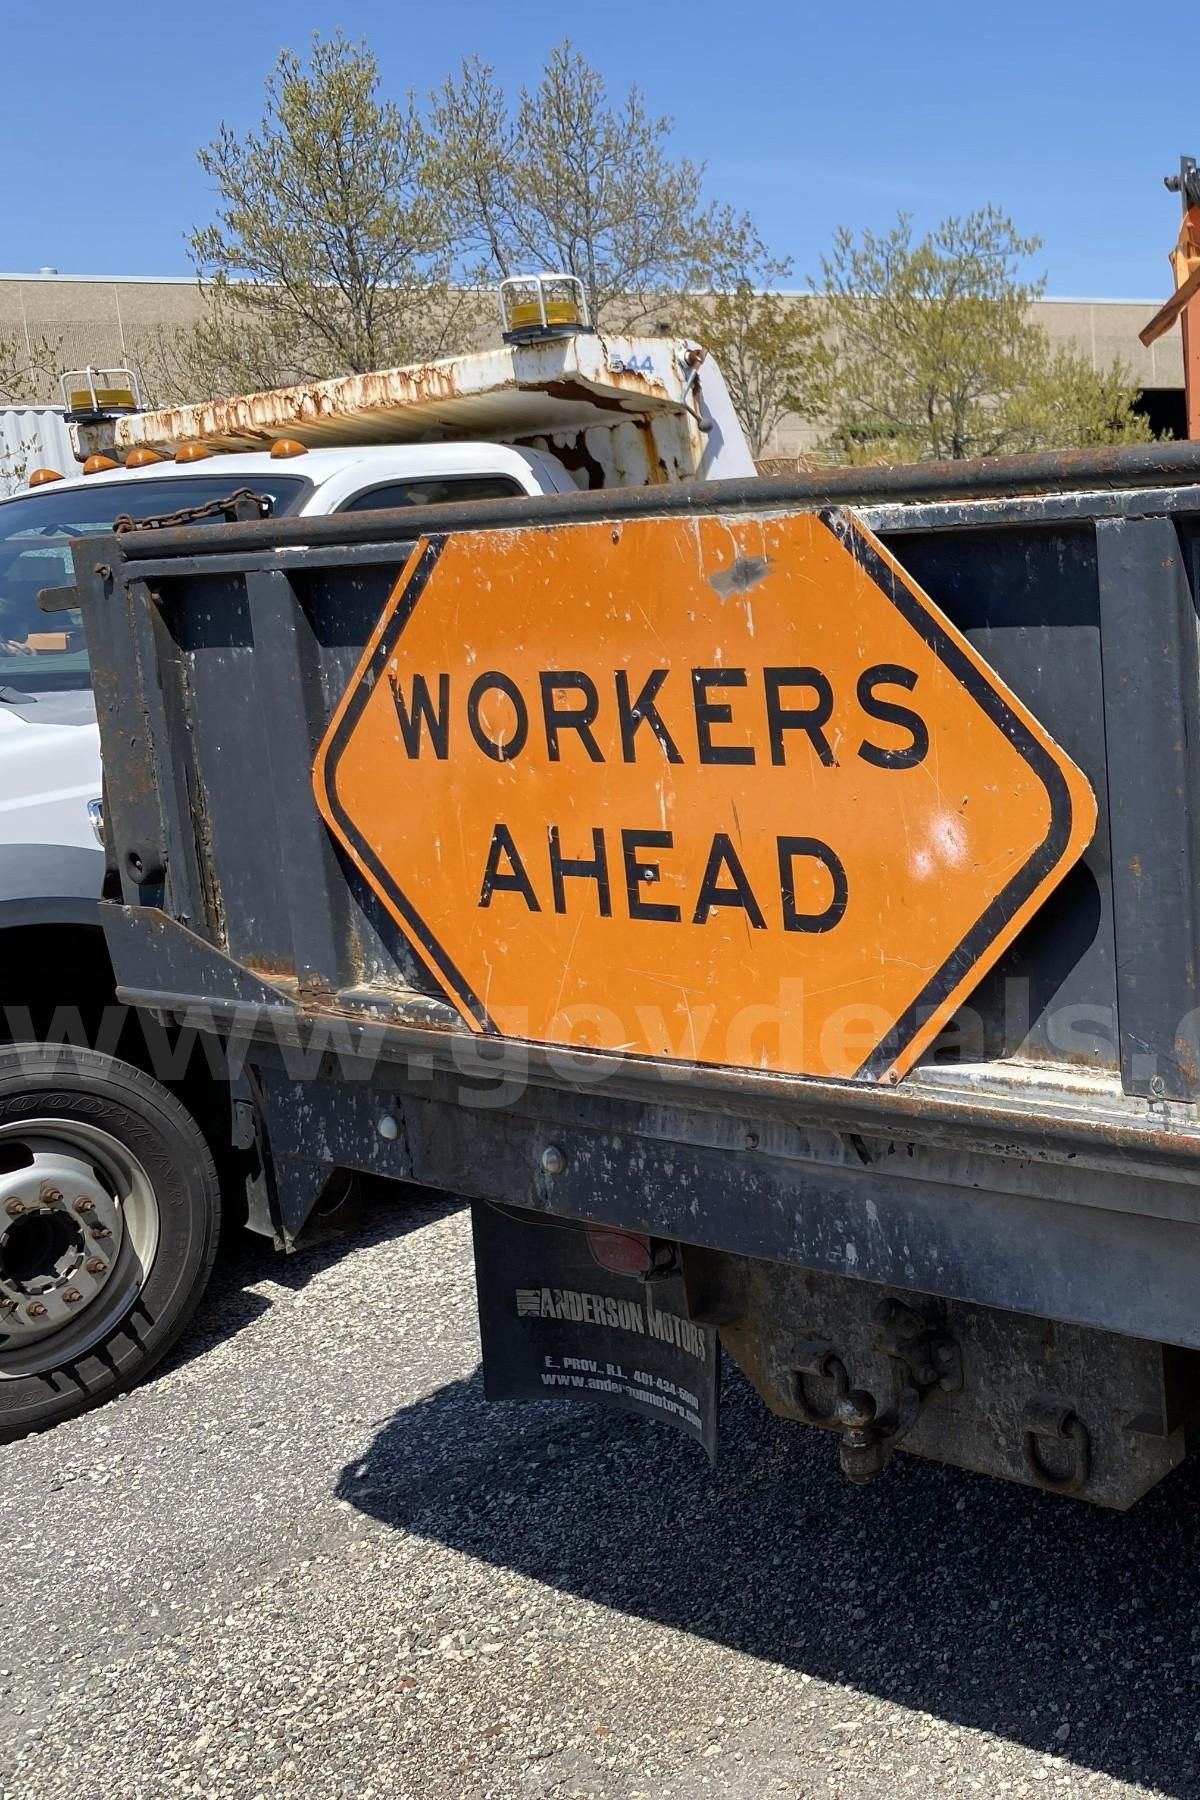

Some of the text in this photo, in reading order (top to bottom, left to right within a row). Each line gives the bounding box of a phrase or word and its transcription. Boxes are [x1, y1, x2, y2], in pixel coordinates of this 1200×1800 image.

[386, 663, 929, 770] WORKERS
[478, 823, 849, 933] AHEAD
[541, 1287, 706, 1362] ANDERSON MOTORS
